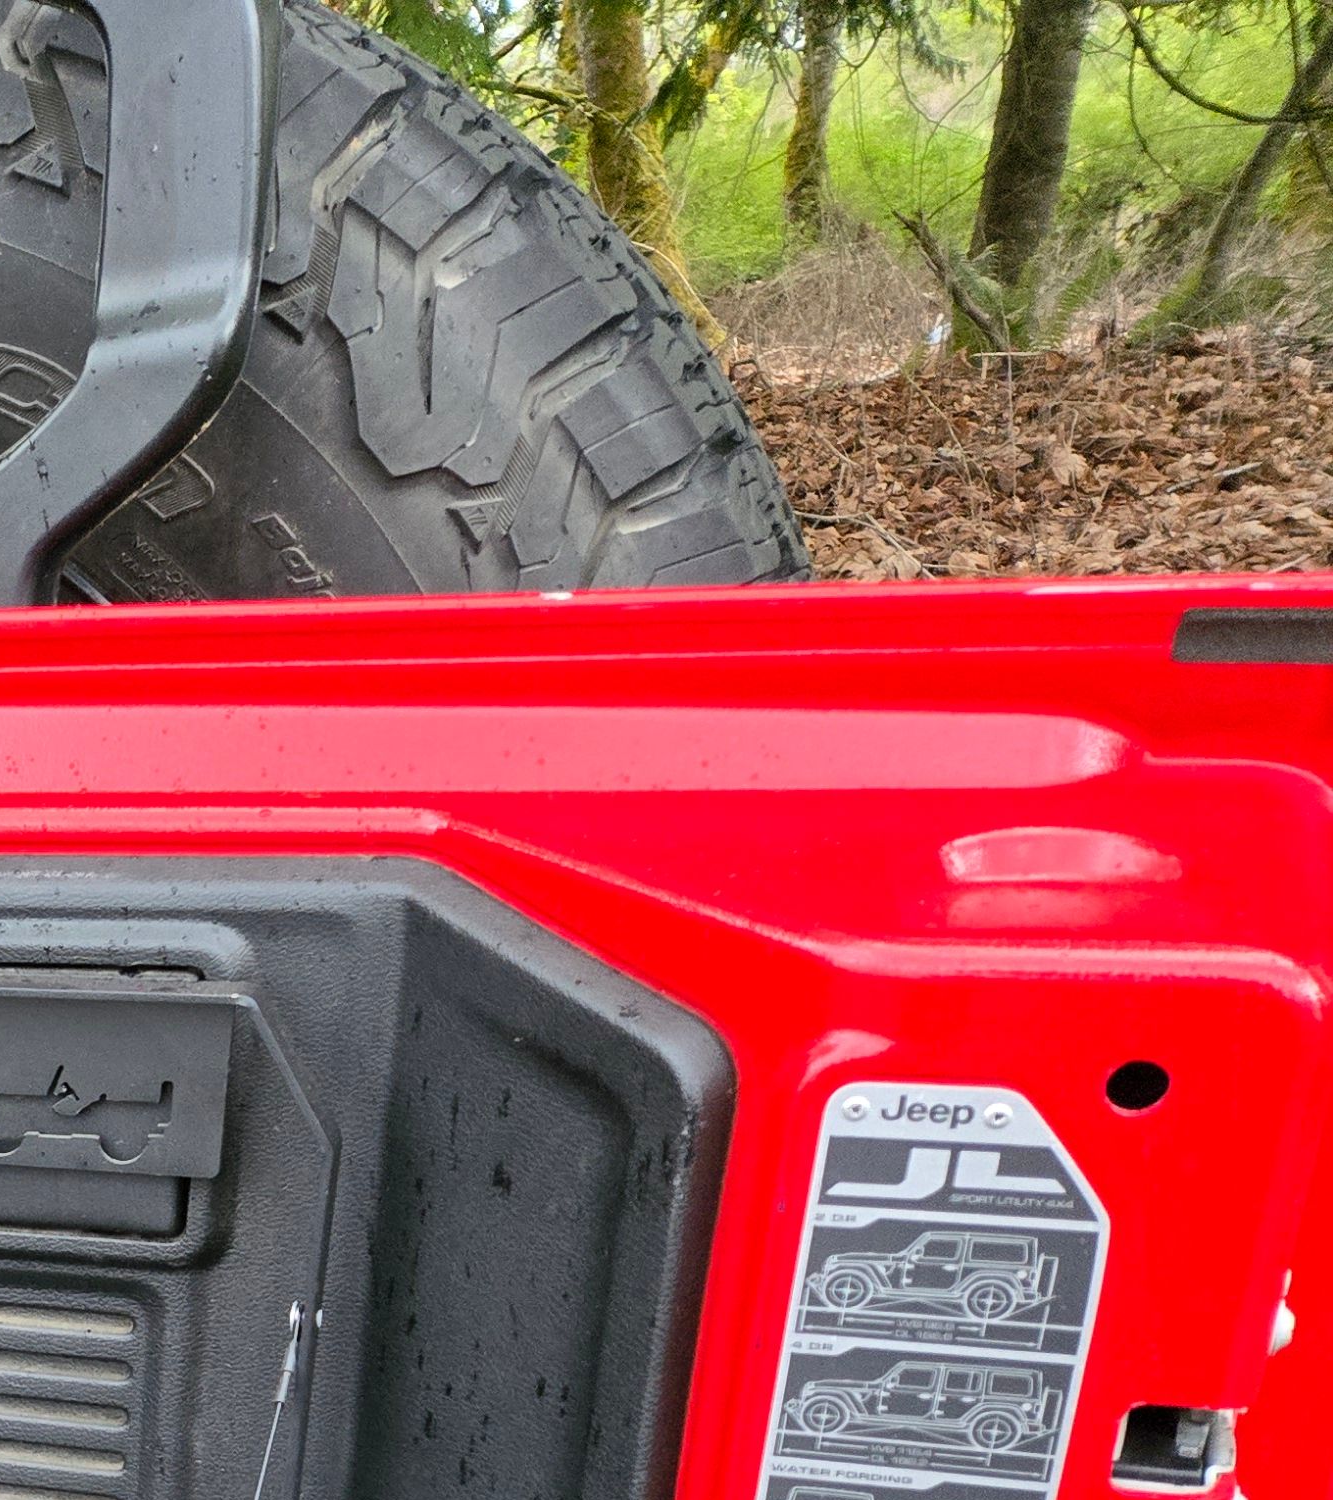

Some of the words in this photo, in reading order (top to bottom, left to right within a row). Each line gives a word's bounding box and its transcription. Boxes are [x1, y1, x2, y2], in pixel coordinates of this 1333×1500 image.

[881, 1094, 975, 1130] Jeep
[825, 1147, 1067, 1200] JL
[771, 1462, 831, 1477] WATER
[835, 1470, 914, 1485] FORDING
